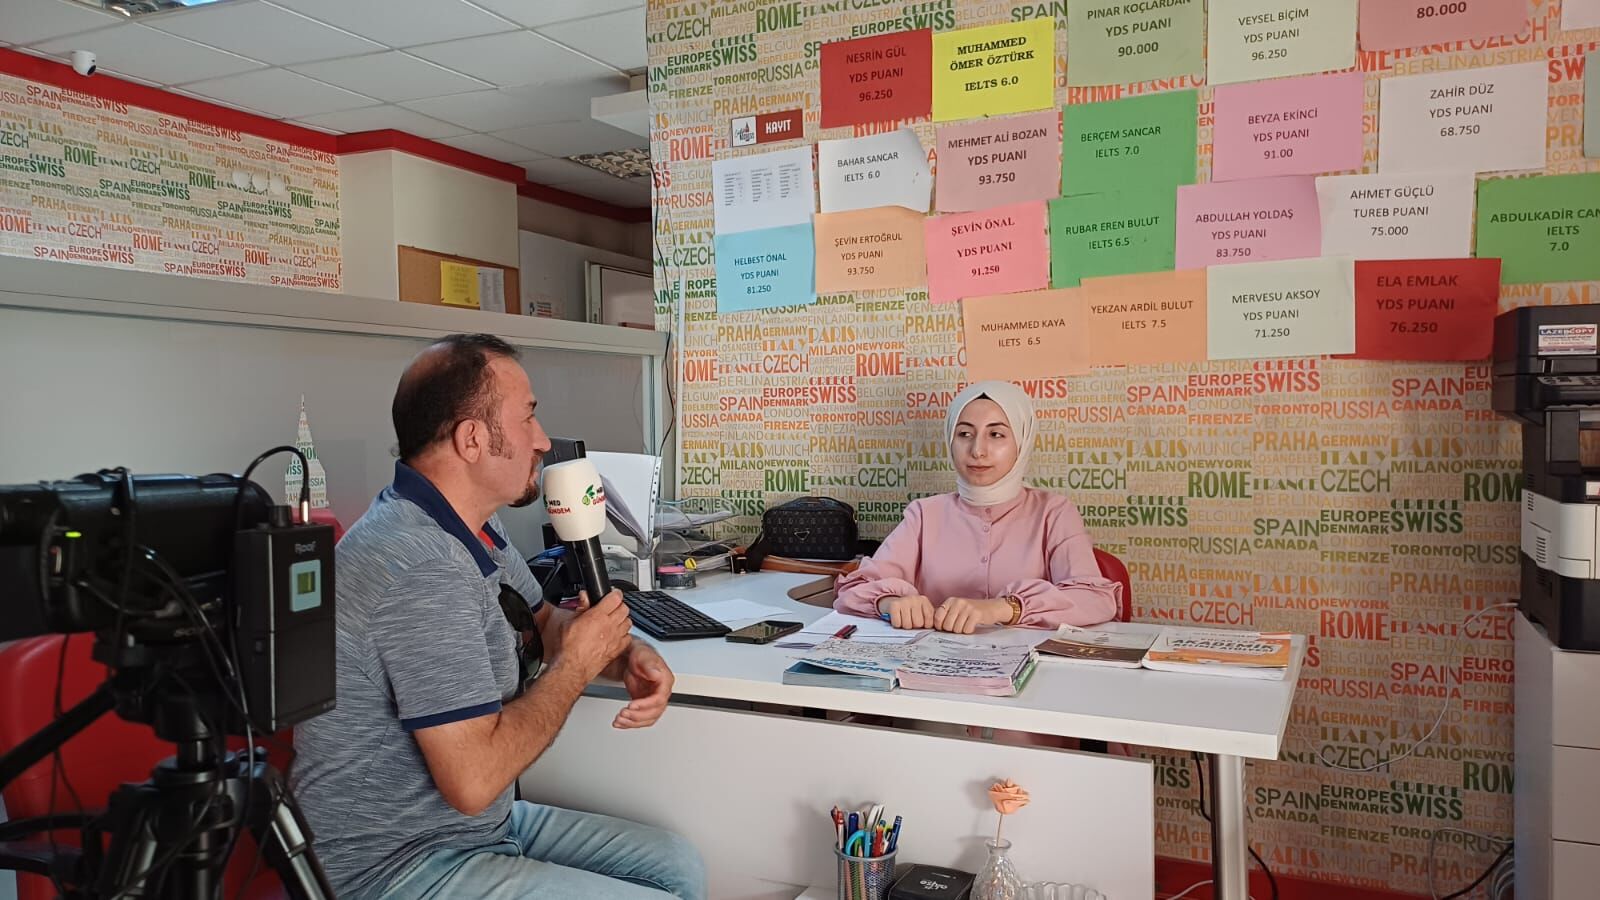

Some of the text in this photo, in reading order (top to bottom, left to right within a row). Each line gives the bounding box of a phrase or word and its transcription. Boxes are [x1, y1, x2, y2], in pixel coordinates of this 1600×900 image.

[711, 2, 755, 19] MILANO
[1087, 6, 1120, 20] PINAR
[1238, 8, 1309, 26] VEYSEL BİÇİM
[1416, 2, 1467, 19] 80.000
[756, 6, 803, 33] ROME
[667, 16, 711, 42] CZECH
[1105, 17, 1172, 38] YDS PUANI
[1243, 29, 1300, 44] YDS PUANI
[957, 37, 1027, 55] MUHAMMED
[1118, 42, 1159, 57] 90.000
[668, 51, 712, 67] EUROPE
[712, 43, 757, 67] SWISS
[846, 46, 906, 64] NESRİN GÜL
[950, 50, 1035, 71] ÖMER ÖZTÜRK
[1252, 49, 1287, 61] 96.250
[668, 62, 712, 76] DENMARK
[757, 62, 804, 84] RUSSIA
[849, 68, 903, 84] YDS PUANI
[713, 72, 758, 86] TORONTO
[965, 76, 1019, 91] IELTS 6.0
[669, 85, 713, 99] FIRENZE
[859, 89, 893, 102] 96.250
[1430, 83, 1494, 99] ZAHİR DÜZ
[95, 97, 128, 115] SWISS
[713, 94, 758, 117] PRAHA
[1430, 104, 1493, 119] YDS PUANI
[1248, 107, 1318, 125] BEYZA EKİNCİ
[766, 120, 791, 134] KAYIT
[1081, 126, 1161, 143] BERÇEM SANCAR
[1440, 124, 1480, 137] 68.750
[948, 128, 1048, 149] MEHMET ALİ BOZAN
[1253, 129, 1309, 142] YDS PUANI
[670, 135, 714, 162] ROME
[1096, 146, 1139, 158] IELTS 7.0
[1263, 148, 1293, 159] 91.00
[65, 146, 97, 167] ROME
[837, 152, 899, 168] BAHAR SANCAR
[967, 150, 1027, 166] YDS PUANI
[30, 161, 65, 178] SWISS
[189, 171, 216, 190] ROME
[844, 172, 864, 183] IELTS
[979, 172, 1016, 185] 93.750
[65, 183, 99, 198] RUSSIA
[100, 179, 131, 193] SPAIN
[1350, 186, 1434, 199] AHMET GÜÇLÜ
[1195, 209, 1294, 223] ABDULLAH YOLDAŞ
[1353, 206, 1429, 218] TUREB PUANI
[1490, 209, 1573, 223] ABDULKADİR
[68, 223, 101, 239] CZECH
[951, 217, 1015, 237] ŞEVİN ÖNAL
[1066, 216, 1160, 235] RUBAR EREN BULUT
[1371, 226, 1409, 236] 75.000
[1547, 225, 1580, 236] IELTS
[133, 233, 163, 251] ROME
[859, 232, 903, 244] ERTOĞRUL
[1211, 229, 1266, 240] YDS PUANI
[957, 241, 1013, 258] YDS PUANI
[1088, 237, 1130, 250] IELTS 6.5
[1550, 242, 1569, 251] 7.0
[34, 246, 69, 260] SPAIN
[102, 250, 134, 265] SWISS
[841, 250, 883, 261] YDS PUANI
[1216, 248, 1251, 257] 83.750
[734, 255, 765, 266] HELBEST
[741, 269, 779, 280] YDS PUANI
[847, 266, 875, 276] 93.750
[971, 265, 1000, 277] 91.250
[1376, 275, 1458, 287] ELA EMLAK
[747, 284, 772, 295] 81.250
[1232, 290, 1321, 304] MERVESU AKSOY
[1091, 304, 1127, 314] YEKZAN
[1160, 301, 1193, 310] BULUT
[1376, 299, 1455, 310] YDS PUANI
[1243, 310, 1299, 321] YDS PUANI
[981, 318, 1066, 332] MUHAMMED KAYA
[1122, 320, 1166, 330] IELTS 7.5
[1390, 322, 1438, 333] 76.250
[717, 325, 762, 342] PRAHA
[1255, 328, 1290, 338] 71.250
[998, 337, 1041, 347] ILETS 6.5
[763, 354, 809, 374] CZECH
[856, 352, 906, 377] ROME
[1188, 373, 1253, 386] EUROPE
[1253, 371, 1321, 394] SWISS
[763, 387, 809, 398] EUROPE
[809, 386, 857, 404] SWISS
[1127, 385, 1188, 402] SPAIN
[1391, 378, 1464, 397] SPAIN
[720, 396, 763, 411] SPAIN
[720, 413, 763, 422] CANADA
[810, 413, 857, 423] TORONTO
[857, 411, 906, 426] RUSSIA
[1067, 406, 1126, 423] RUSSIA
[764, 469, 810, 492] ROME
[858, 467, 907, 487] CZECH
[1067, 467, 1127, 490] CZECH
[1188, 471, 1252, 498] ROME
[1320, 469, 1390, 492] CZECH
[1126, 505, 1188, 527] SWISS
[1320, 510, 1390, 523] EUROPE
[1390, 511, 1463, 534] SWISS
[1321, 609, 1390, 641] ROME
[1390, 662, 1462, 685] SPAIN
[1390, 792, 1462, 821] SWISS
